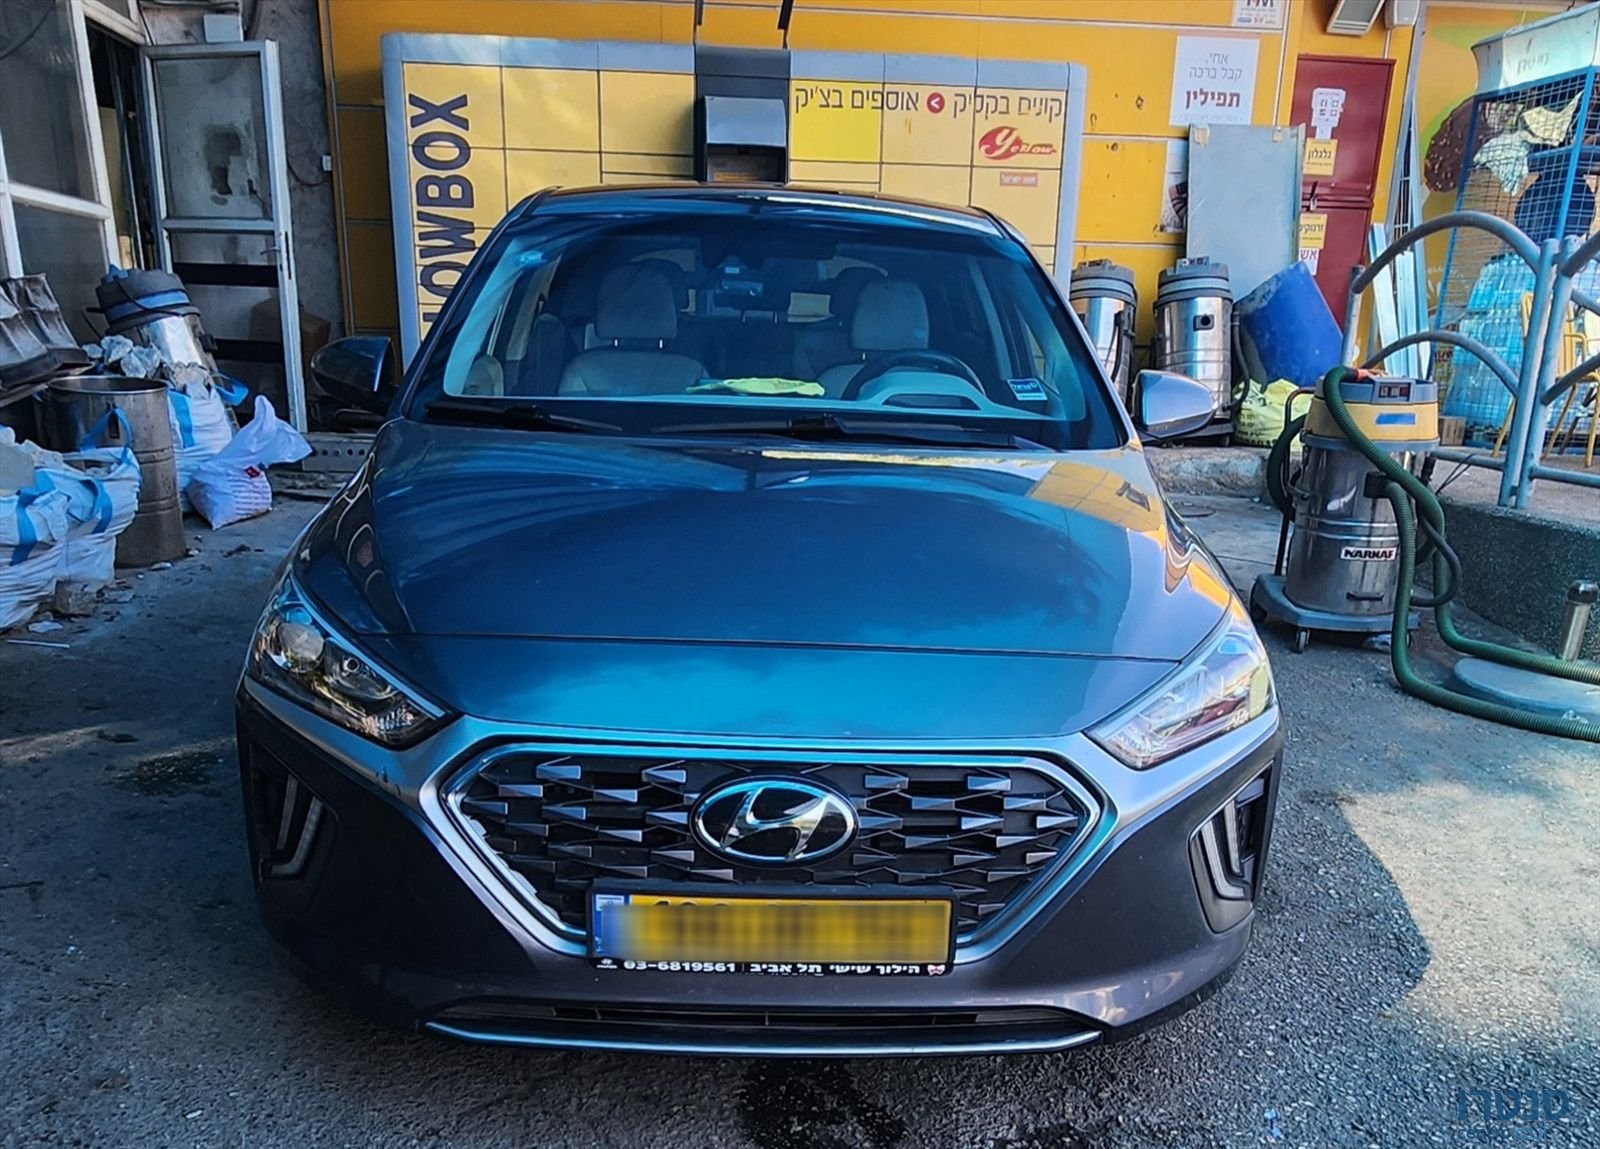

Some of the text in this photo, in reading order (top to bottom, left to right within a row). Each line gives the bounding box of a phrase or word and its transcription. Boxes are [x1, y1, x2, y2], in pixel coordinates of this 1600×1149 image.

[1189, 66, 1243, 83] קבל ברכה
[851, 89, 919, 111] אוספים
[1185, 87, 1241, 110] תפילין
[408, 92, 476, 324] OWBOX
[623, 959, 736, 973] 03-6819561
[750, 963, 793, 973] אביב
[797, 963, 822, 974] תל
[829, 963, 871, 974] שישי
[875, 964, 920, 975] הילוך
